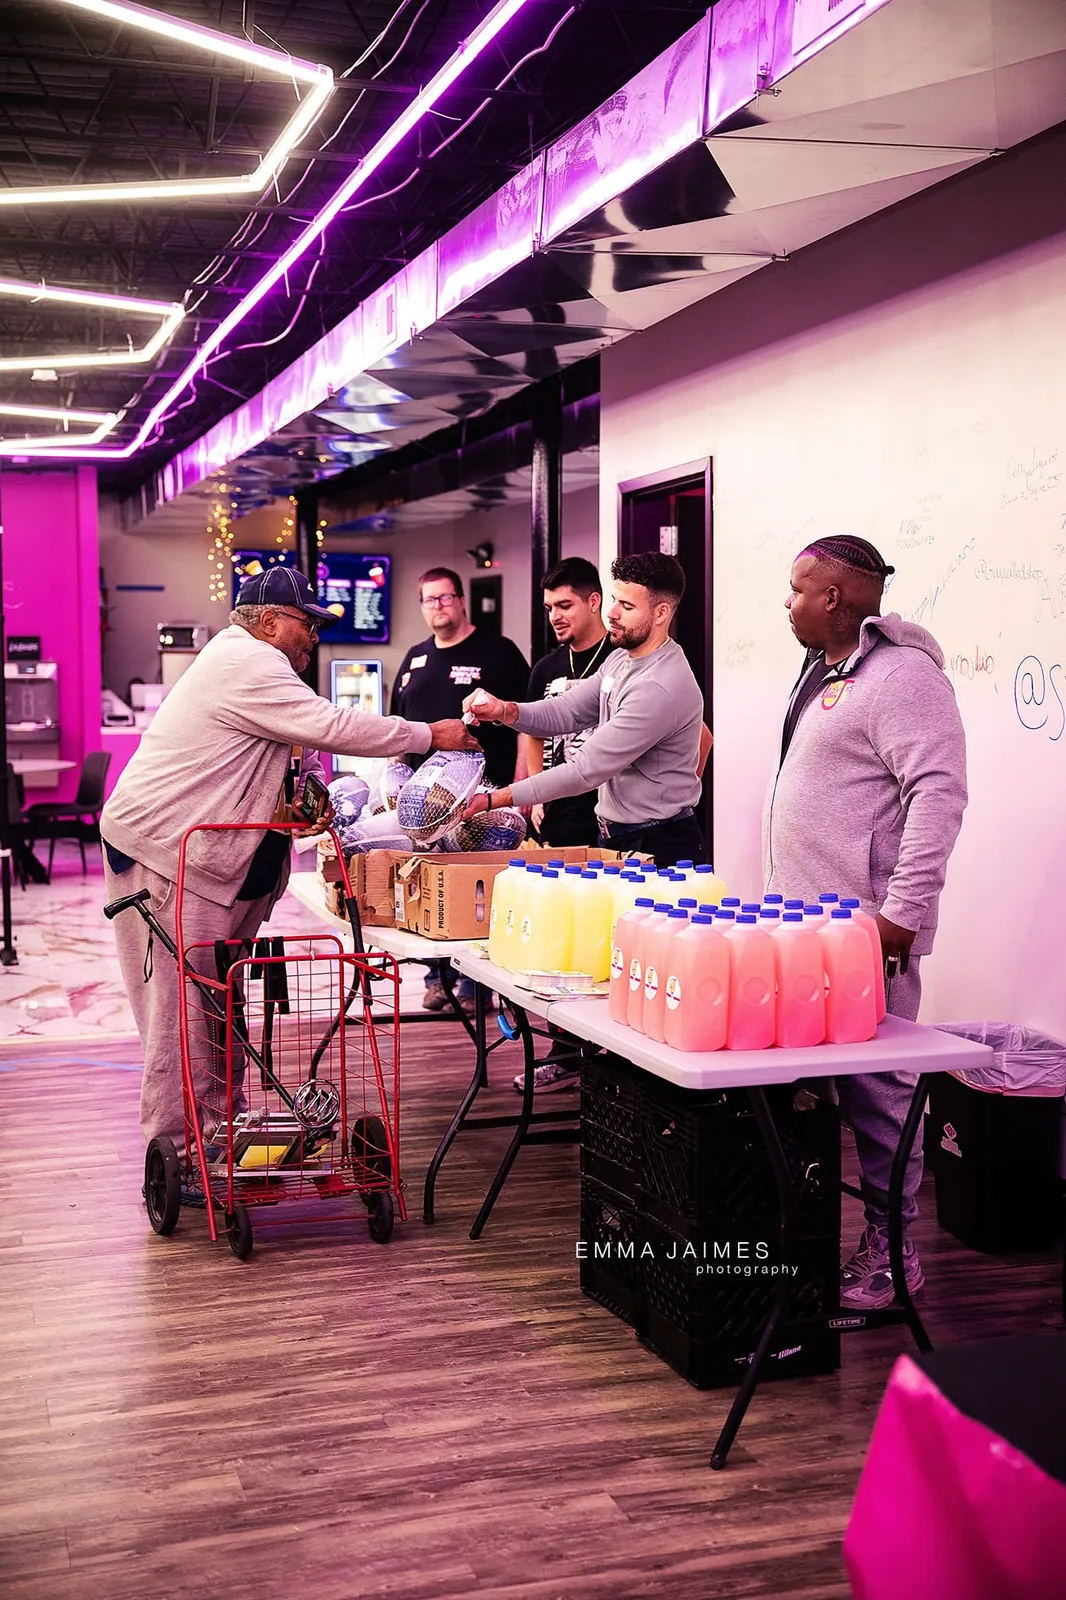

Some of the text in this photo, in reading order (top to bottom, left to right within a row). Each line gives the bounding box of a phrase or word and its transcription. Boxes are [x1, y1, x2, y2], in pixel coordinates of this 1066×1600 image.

[437, 869, 445, 929] PRODUCT OF U.S.A.
[833, 1318, 861, 1327] LIFETIME
